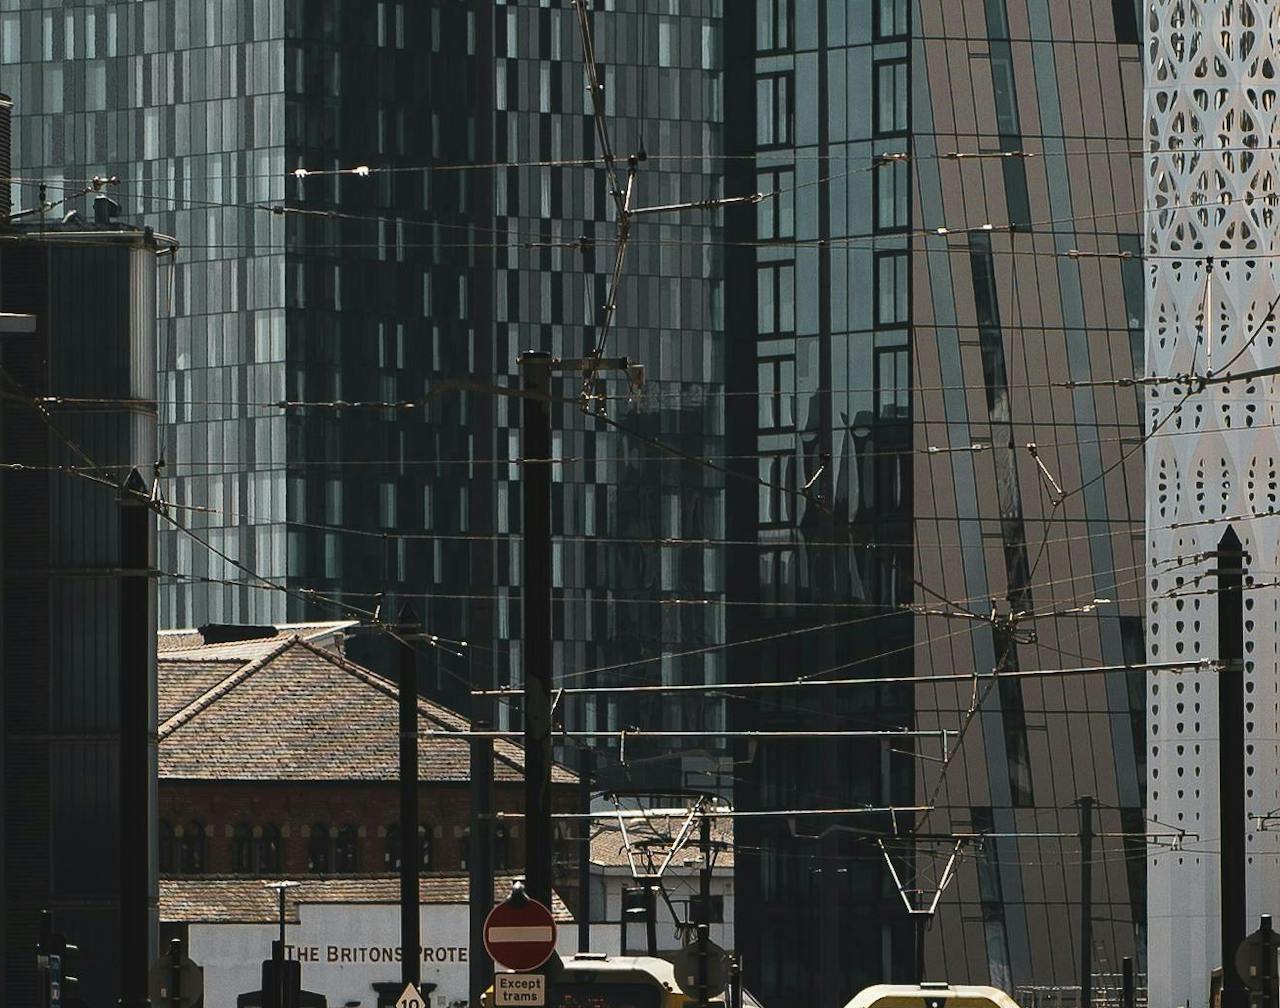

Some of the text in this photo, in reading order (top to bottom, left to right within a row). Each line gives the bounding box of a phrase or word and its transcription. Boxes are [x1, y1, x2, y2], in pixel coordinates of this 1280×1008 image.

[284, 945, 468, 962] THE BRITONS ROTE
[500, 978, 541, 989] Except
[503, 992, 538, 1001] trams
